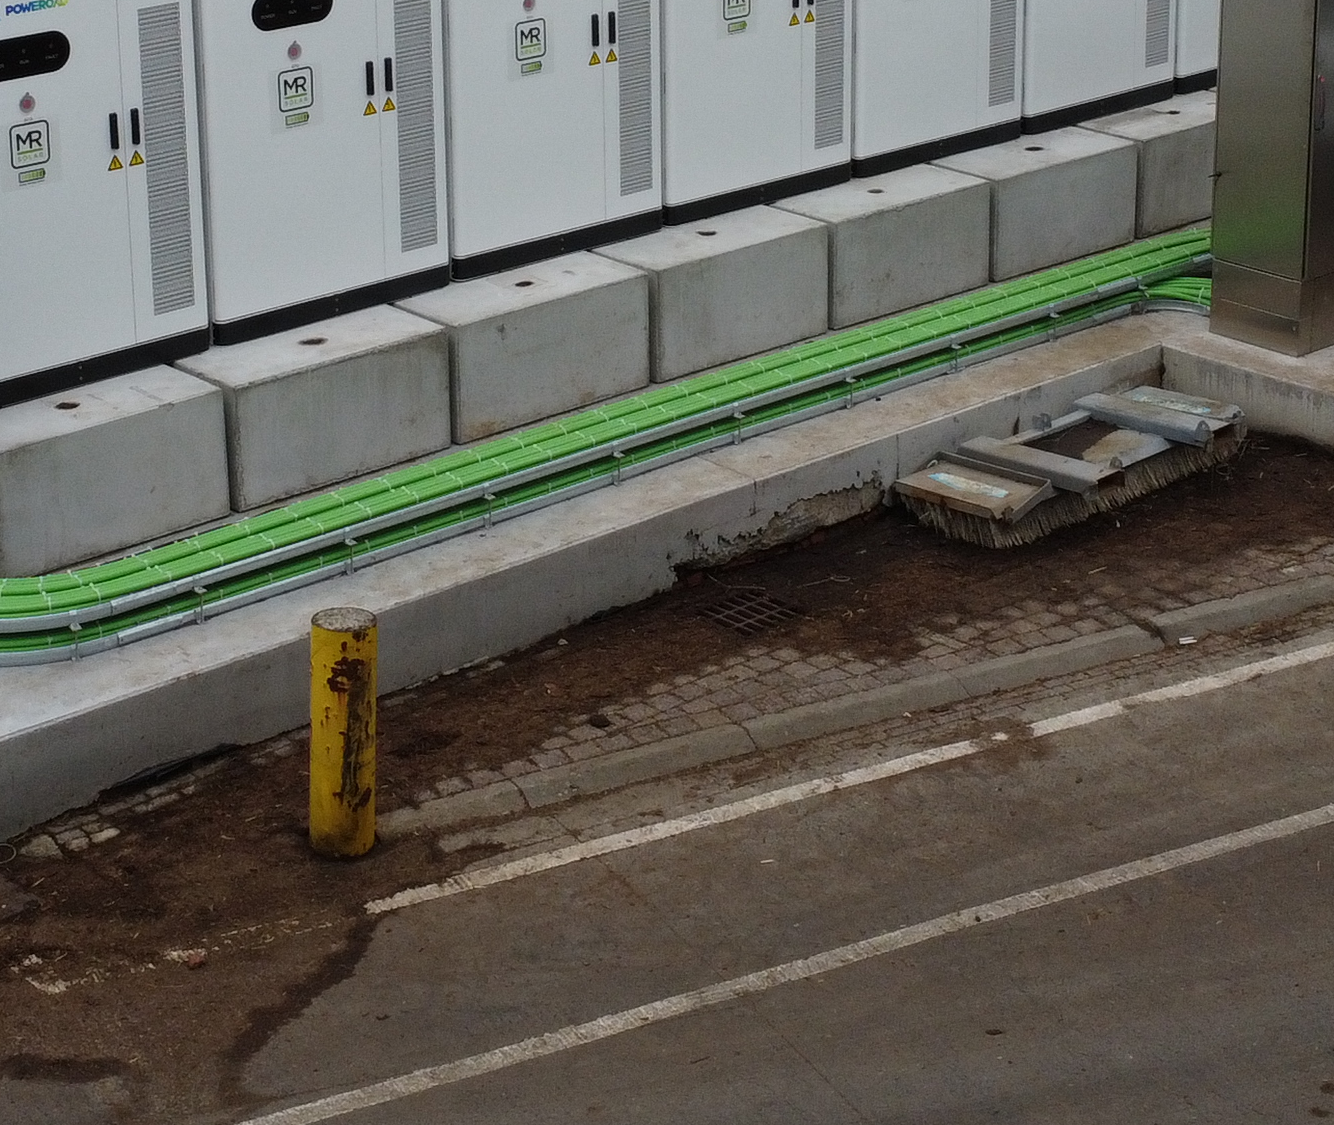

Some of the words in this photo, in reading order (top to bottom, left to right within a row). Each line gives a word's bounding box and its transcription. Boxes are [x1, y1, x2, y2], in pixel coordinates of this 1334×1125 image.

[520, 27, 541, 45] MR
[284, 76, 307, 96] MR
[15, 130, 43, 151] MR
[17, 152, 44, 163] SOLAR
